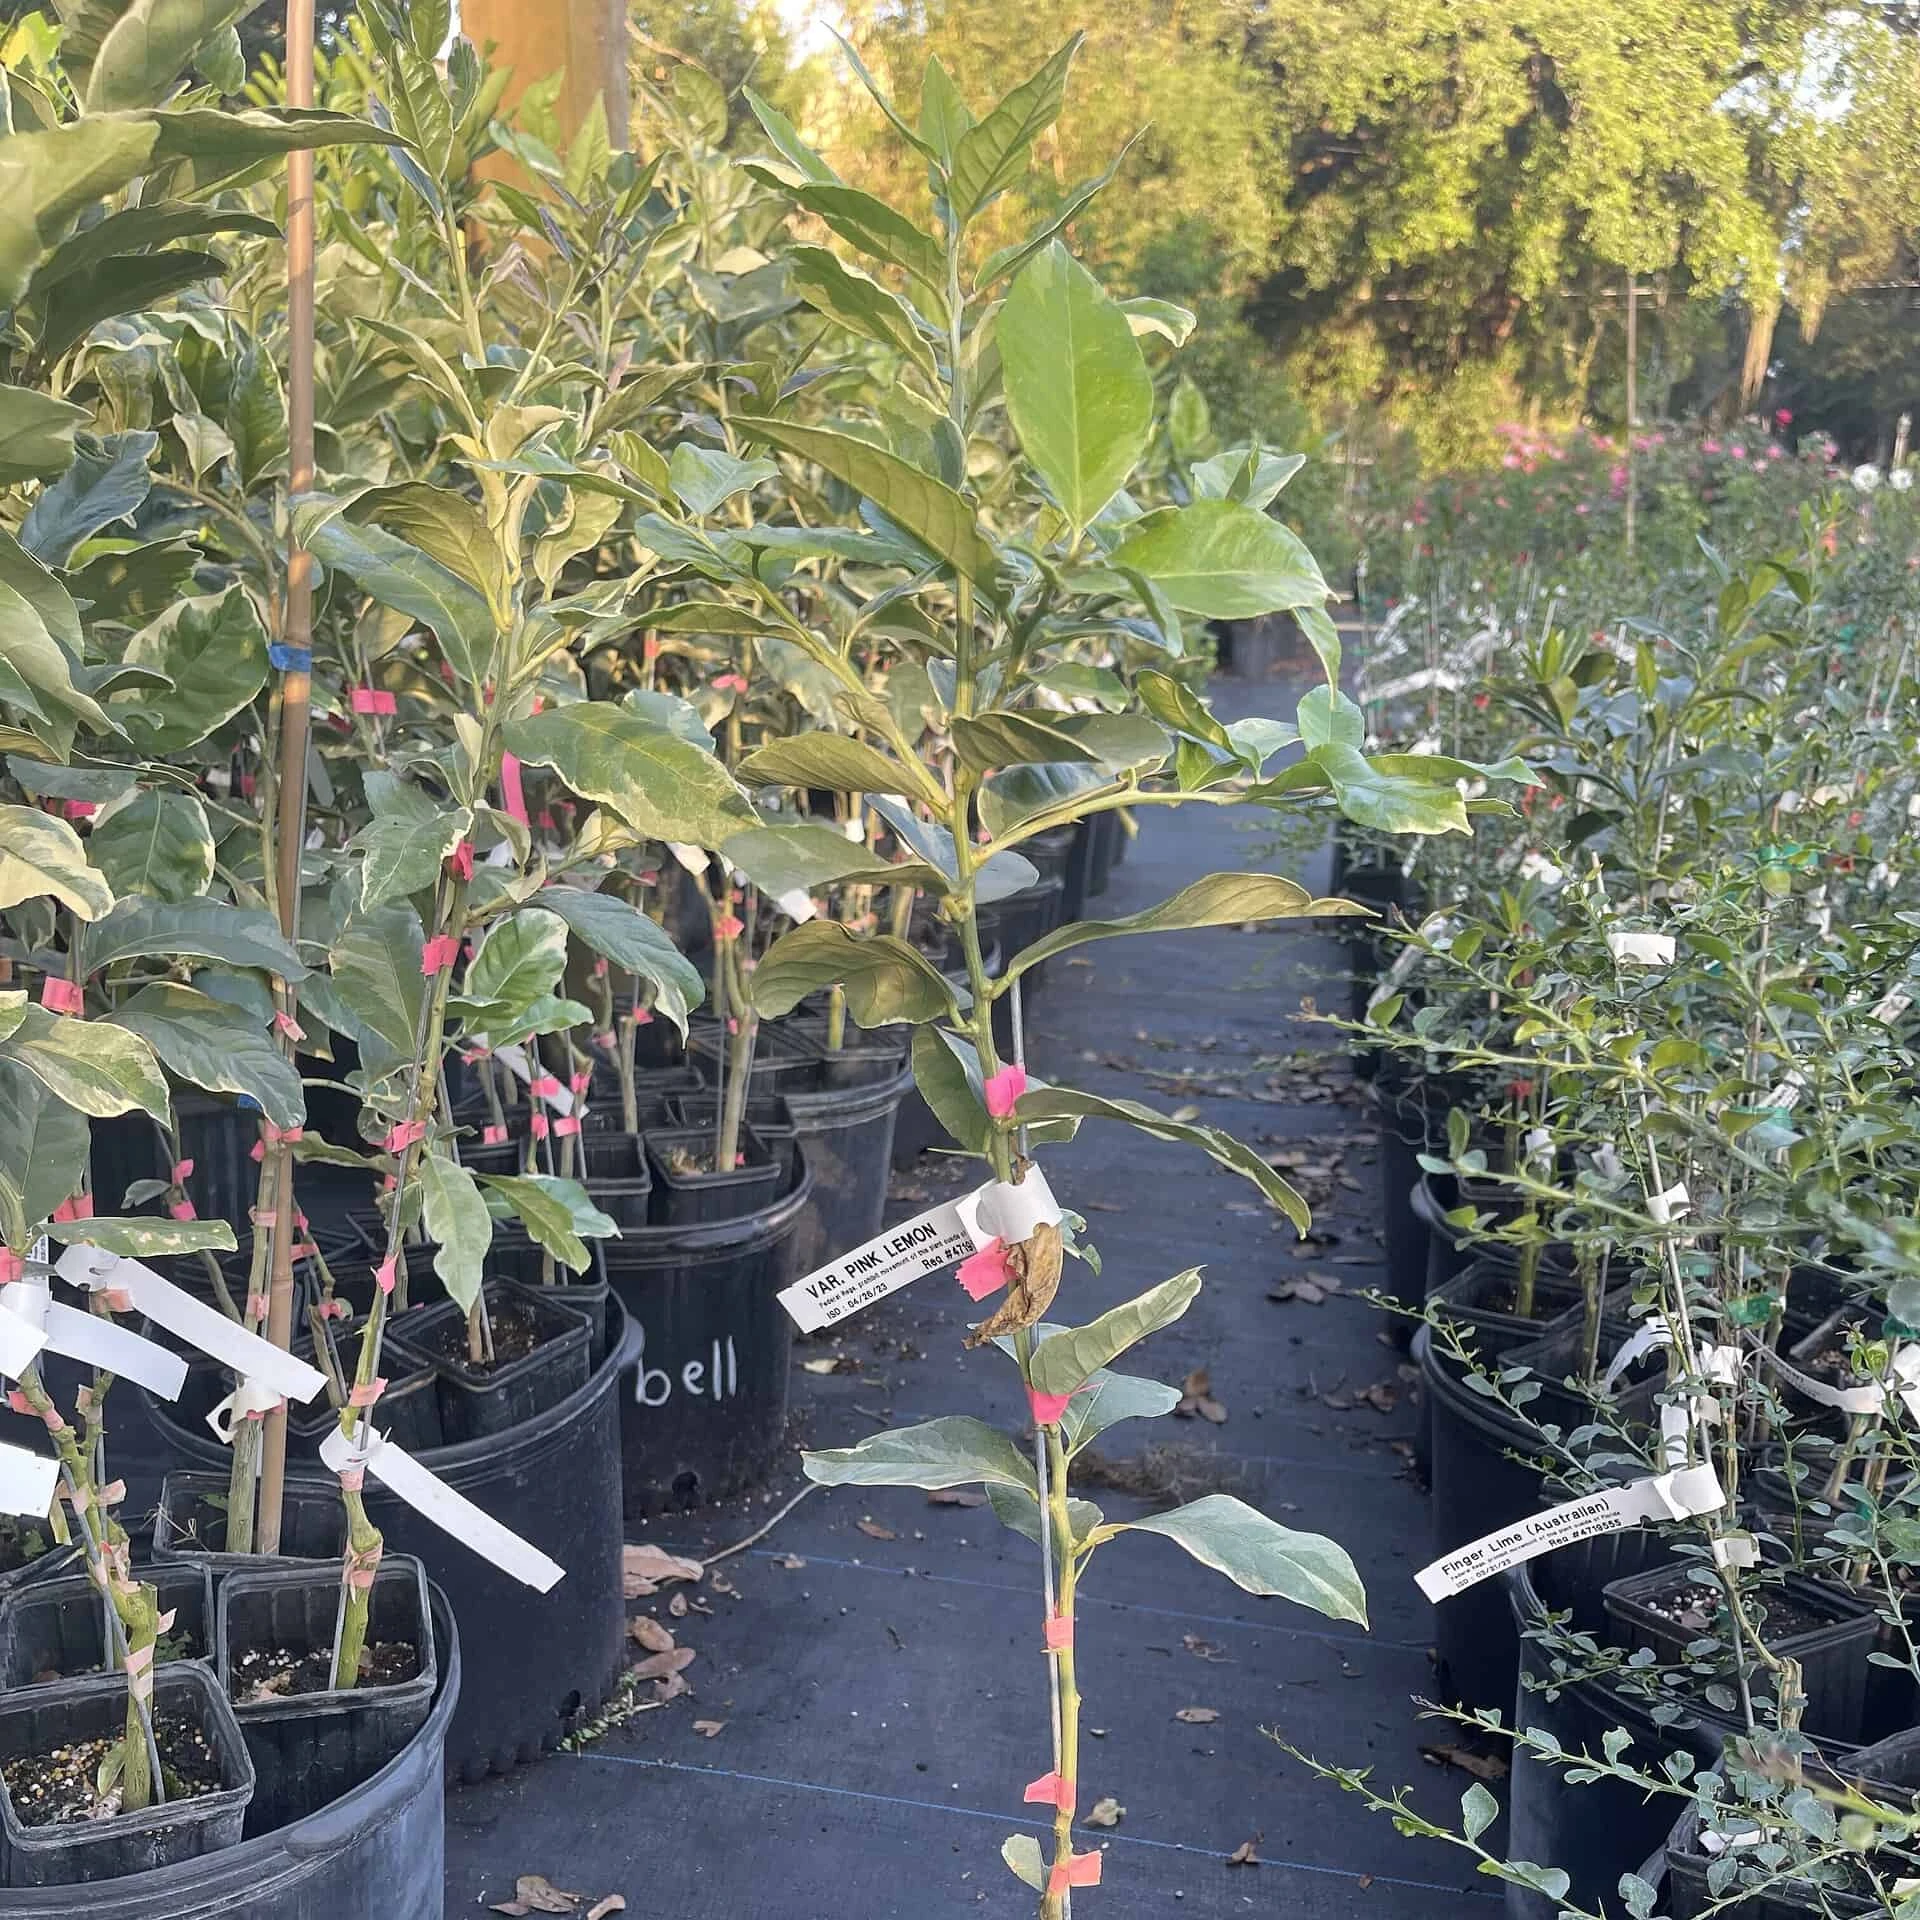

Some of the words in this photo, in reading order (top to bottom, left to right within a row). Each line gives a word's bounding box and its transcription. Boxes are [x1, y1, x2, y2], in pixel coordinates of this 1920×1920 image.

[805, 1274, 845, 1298] VAR.
[844, 1250, 883, 1278] PINK
[883, 1222, 937, 1257] LEMON
[944, 1239, 975, 1260] #4719
[636, 1335, 737, 1407] bell
[1441, 1549, 1484, 1575] Finger
[1488, 1534, 1522, 1552] Lime
[1526, 1498, 1609, 1536] (Australian)
